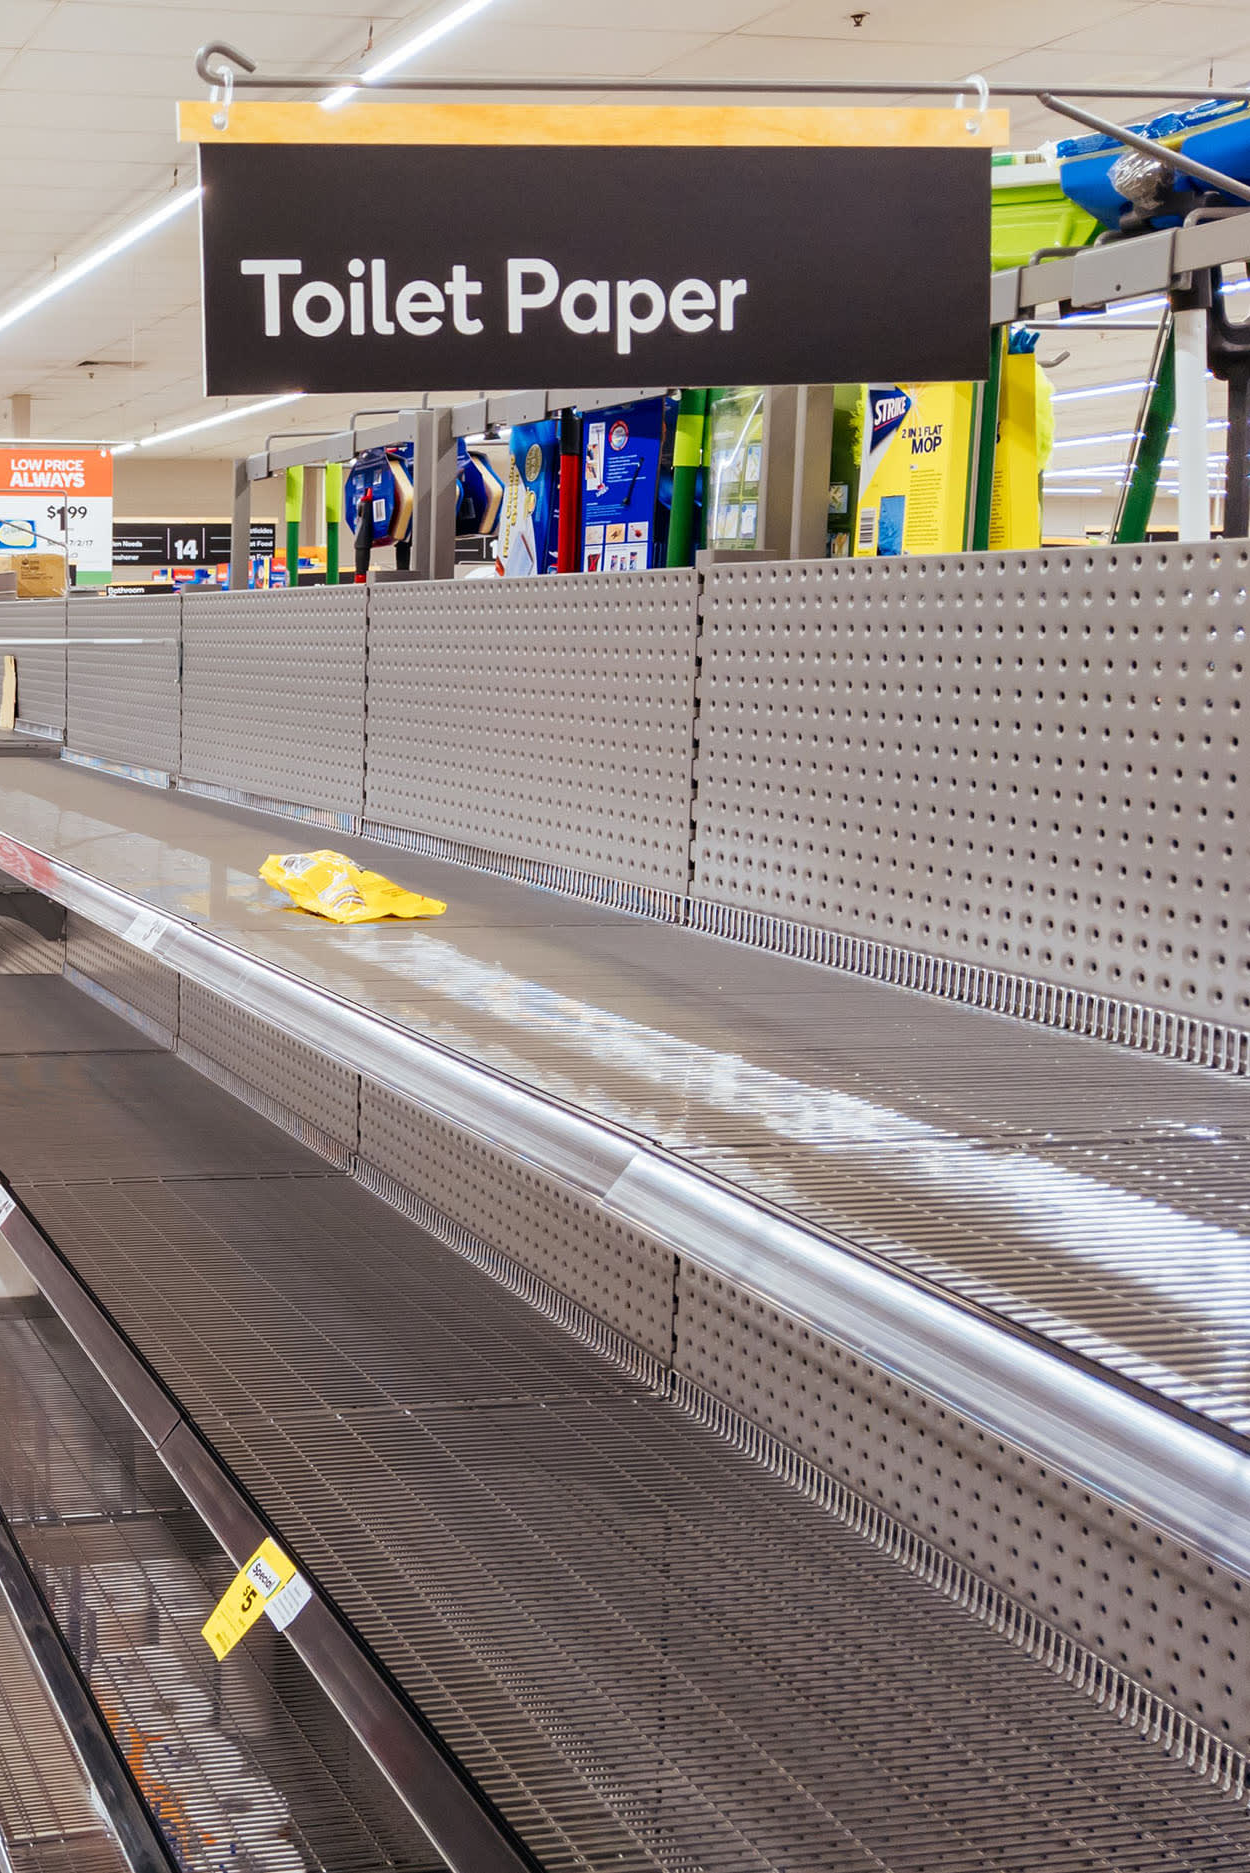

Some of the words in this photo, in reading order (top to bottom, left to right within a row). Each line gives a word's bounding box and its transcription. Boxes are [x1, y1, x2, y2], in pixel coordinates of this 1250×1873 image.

[240, 257, 484, 338] Toilet
[508, 256, 748, 356] Paper
[873, 395, 907, 427] STRIKE
[901, 429, 907, 439] 2
[908, 427, 917, 439] IN
[924, 424, 944, 437] FLAT
[911, 435, 943, 455] MOP
[10, 458, 43, 471] LOW
[44, 458, 85, 472] PRICE
[10, 471, 86, 488] ALWAYS
[173, 539, 199, 561] 14
[256, 540, 273, 548] Food
[107, 586, 145, 595] Bathroom
[251, 1562, 275, 1590] Special
[241, 1584, 258, 1613] $5
